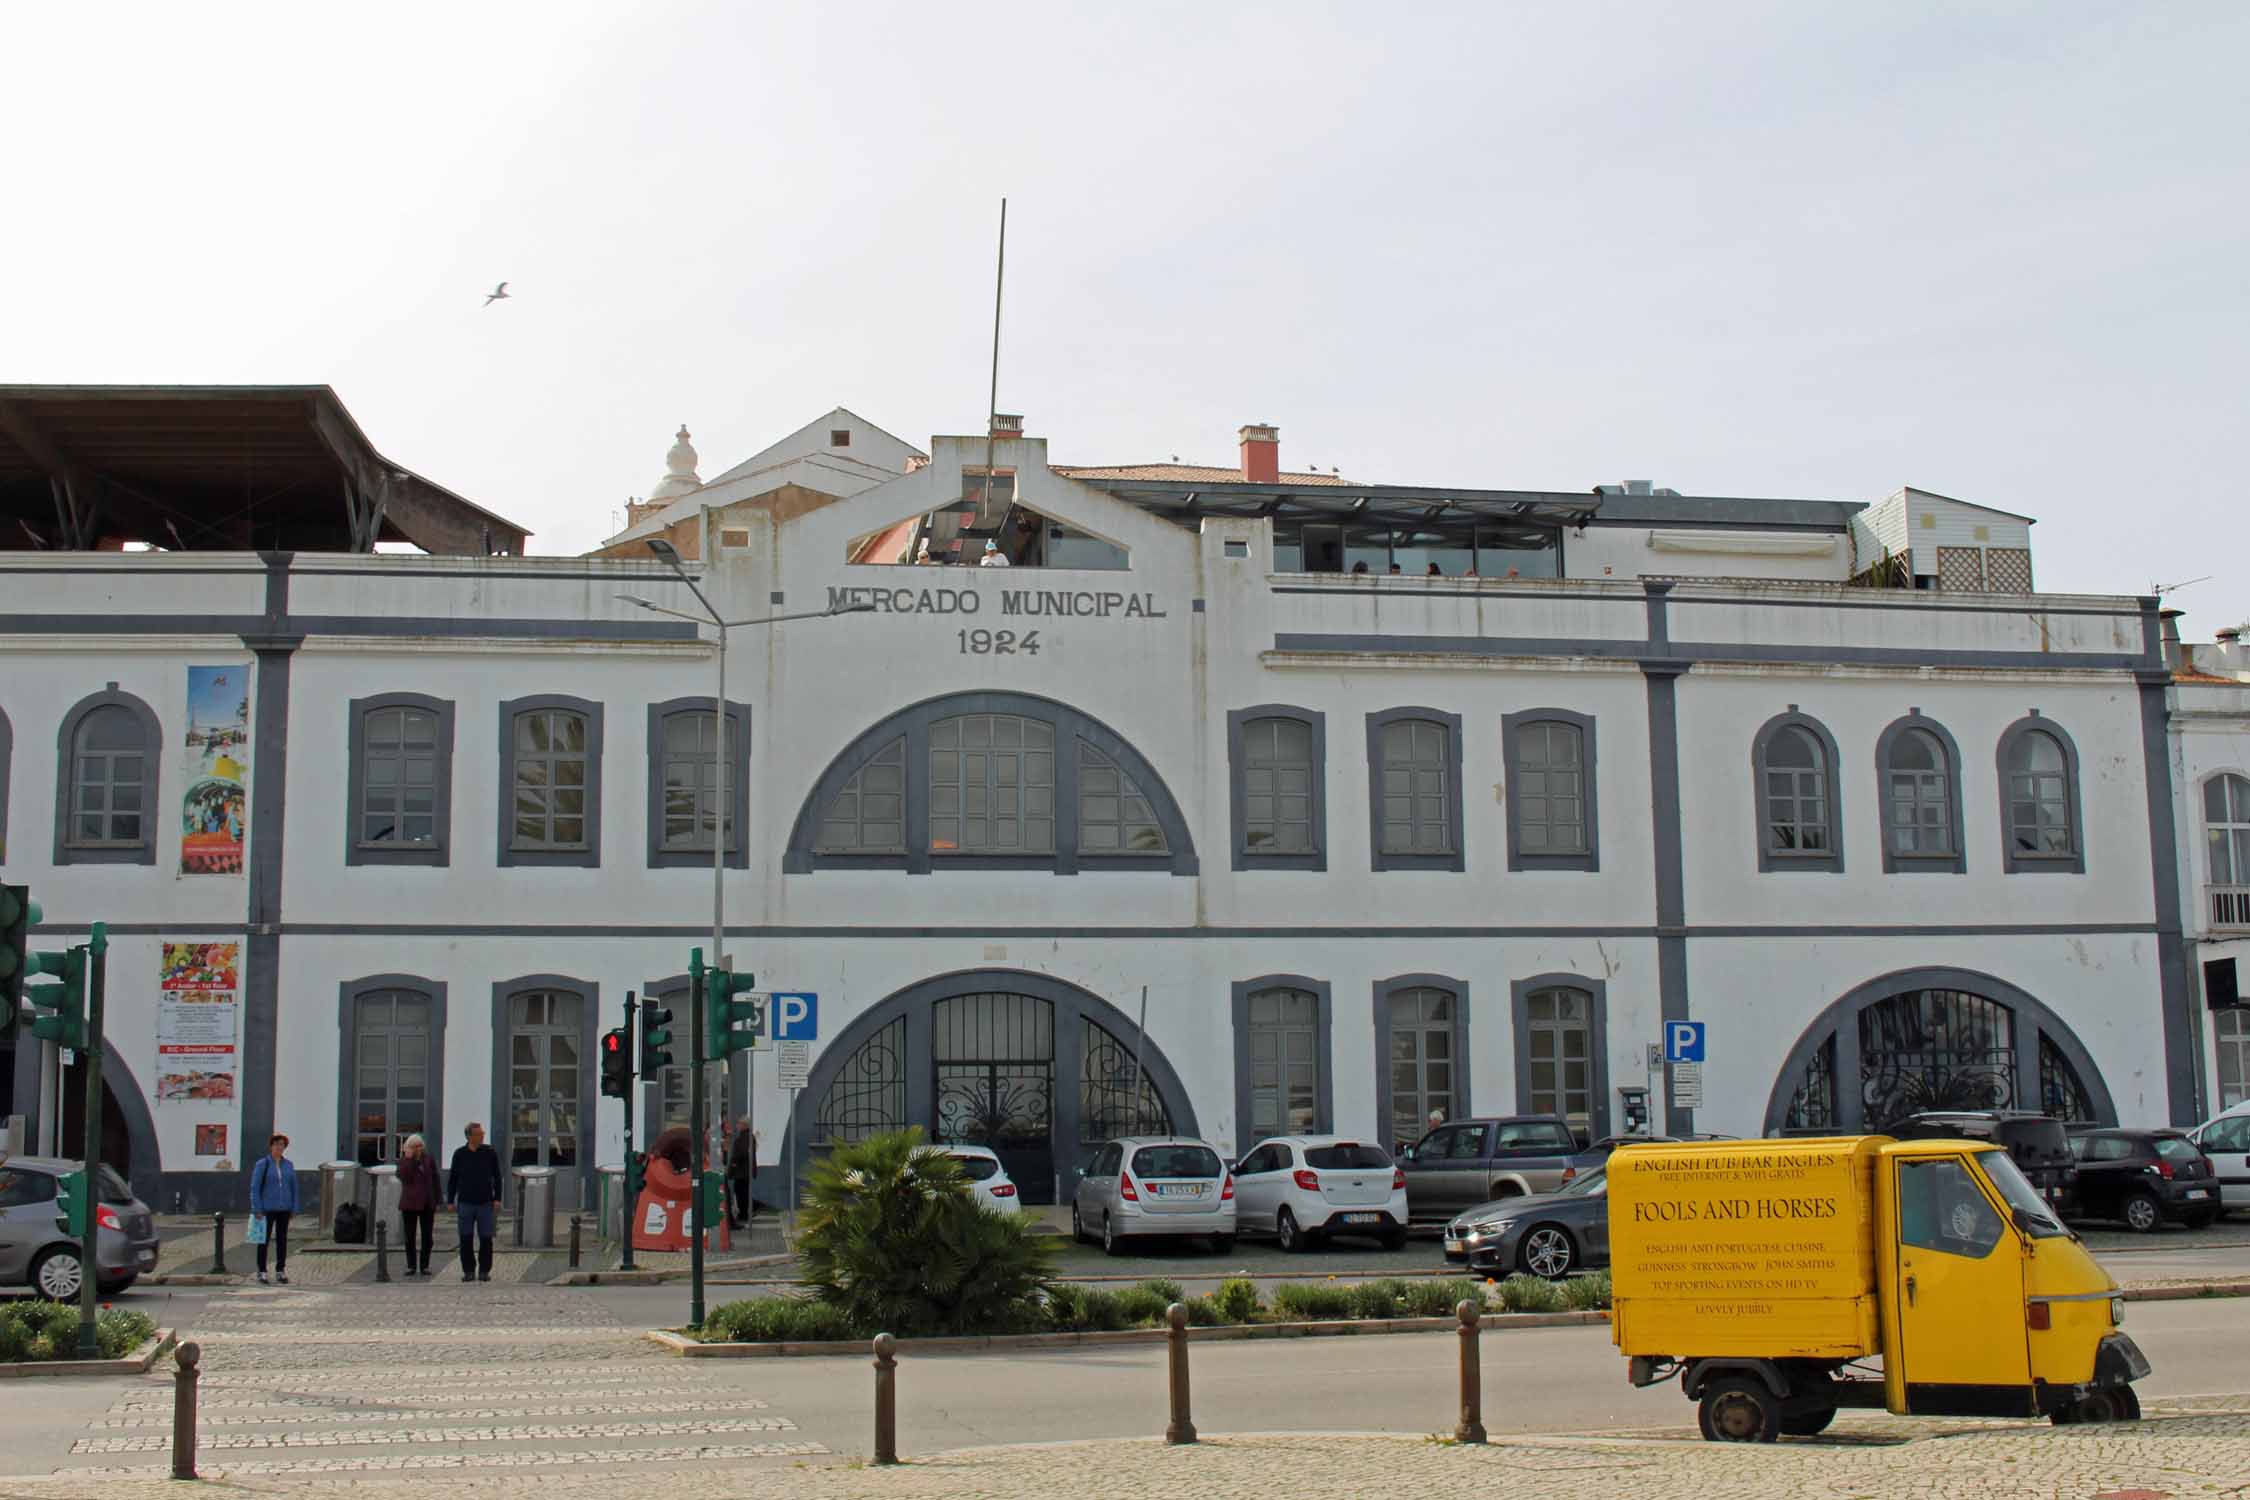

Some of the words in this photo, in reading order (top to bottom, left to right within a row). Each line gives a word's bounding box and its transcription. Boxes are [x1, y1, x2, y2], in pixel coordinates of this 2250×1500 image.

[826, 586, 980, 615] MERCADO
[1001, 590, 1167, 618] MUNICIPAL
[957, 628, 1041, 656] 1924
[779, 996, 808, 1038] P
[1674, 1024, 1697, 1058] P
[1633, 1158, 1699, 1173] ENGLISH
[1659, 1172, 1681, 1182] FREE
[1683, 1171, 1730, 1182] INTERNET
[1768, 1169, 1806, 1179] GRATIS
[1634, 1200, 1697, 1222] FOOLS
[1703, 1199, 1751, 1220] AND
[1757, 1198, 1837, 1218] HORSES
[1646, 1244, 1688, 1255] ENGLISH
[1691, 1243, 1714, 1254] AND
[1715, 1242, 1779, 1254] PORTUGUESE
[1783, 1242, 1825, 1254] CUISINE
[1637, 1263, 1687, 1273] GUINNESS
[1692, 1262, 1757, 1272] STRONGBOW
[1764, 1260, 1793, 1272] JOHN
[1652, 1280, 1671, 1289] TOP
[1676, 1280, 1724, 1289] SPORTING
[1726, 1279, 1764, 1289] EVENTS
[1766, 1279, 1783, 1288] ON
[1785, 1279, 1802, 1288] HD
[1804, 1279, 1819, 1288] TV
